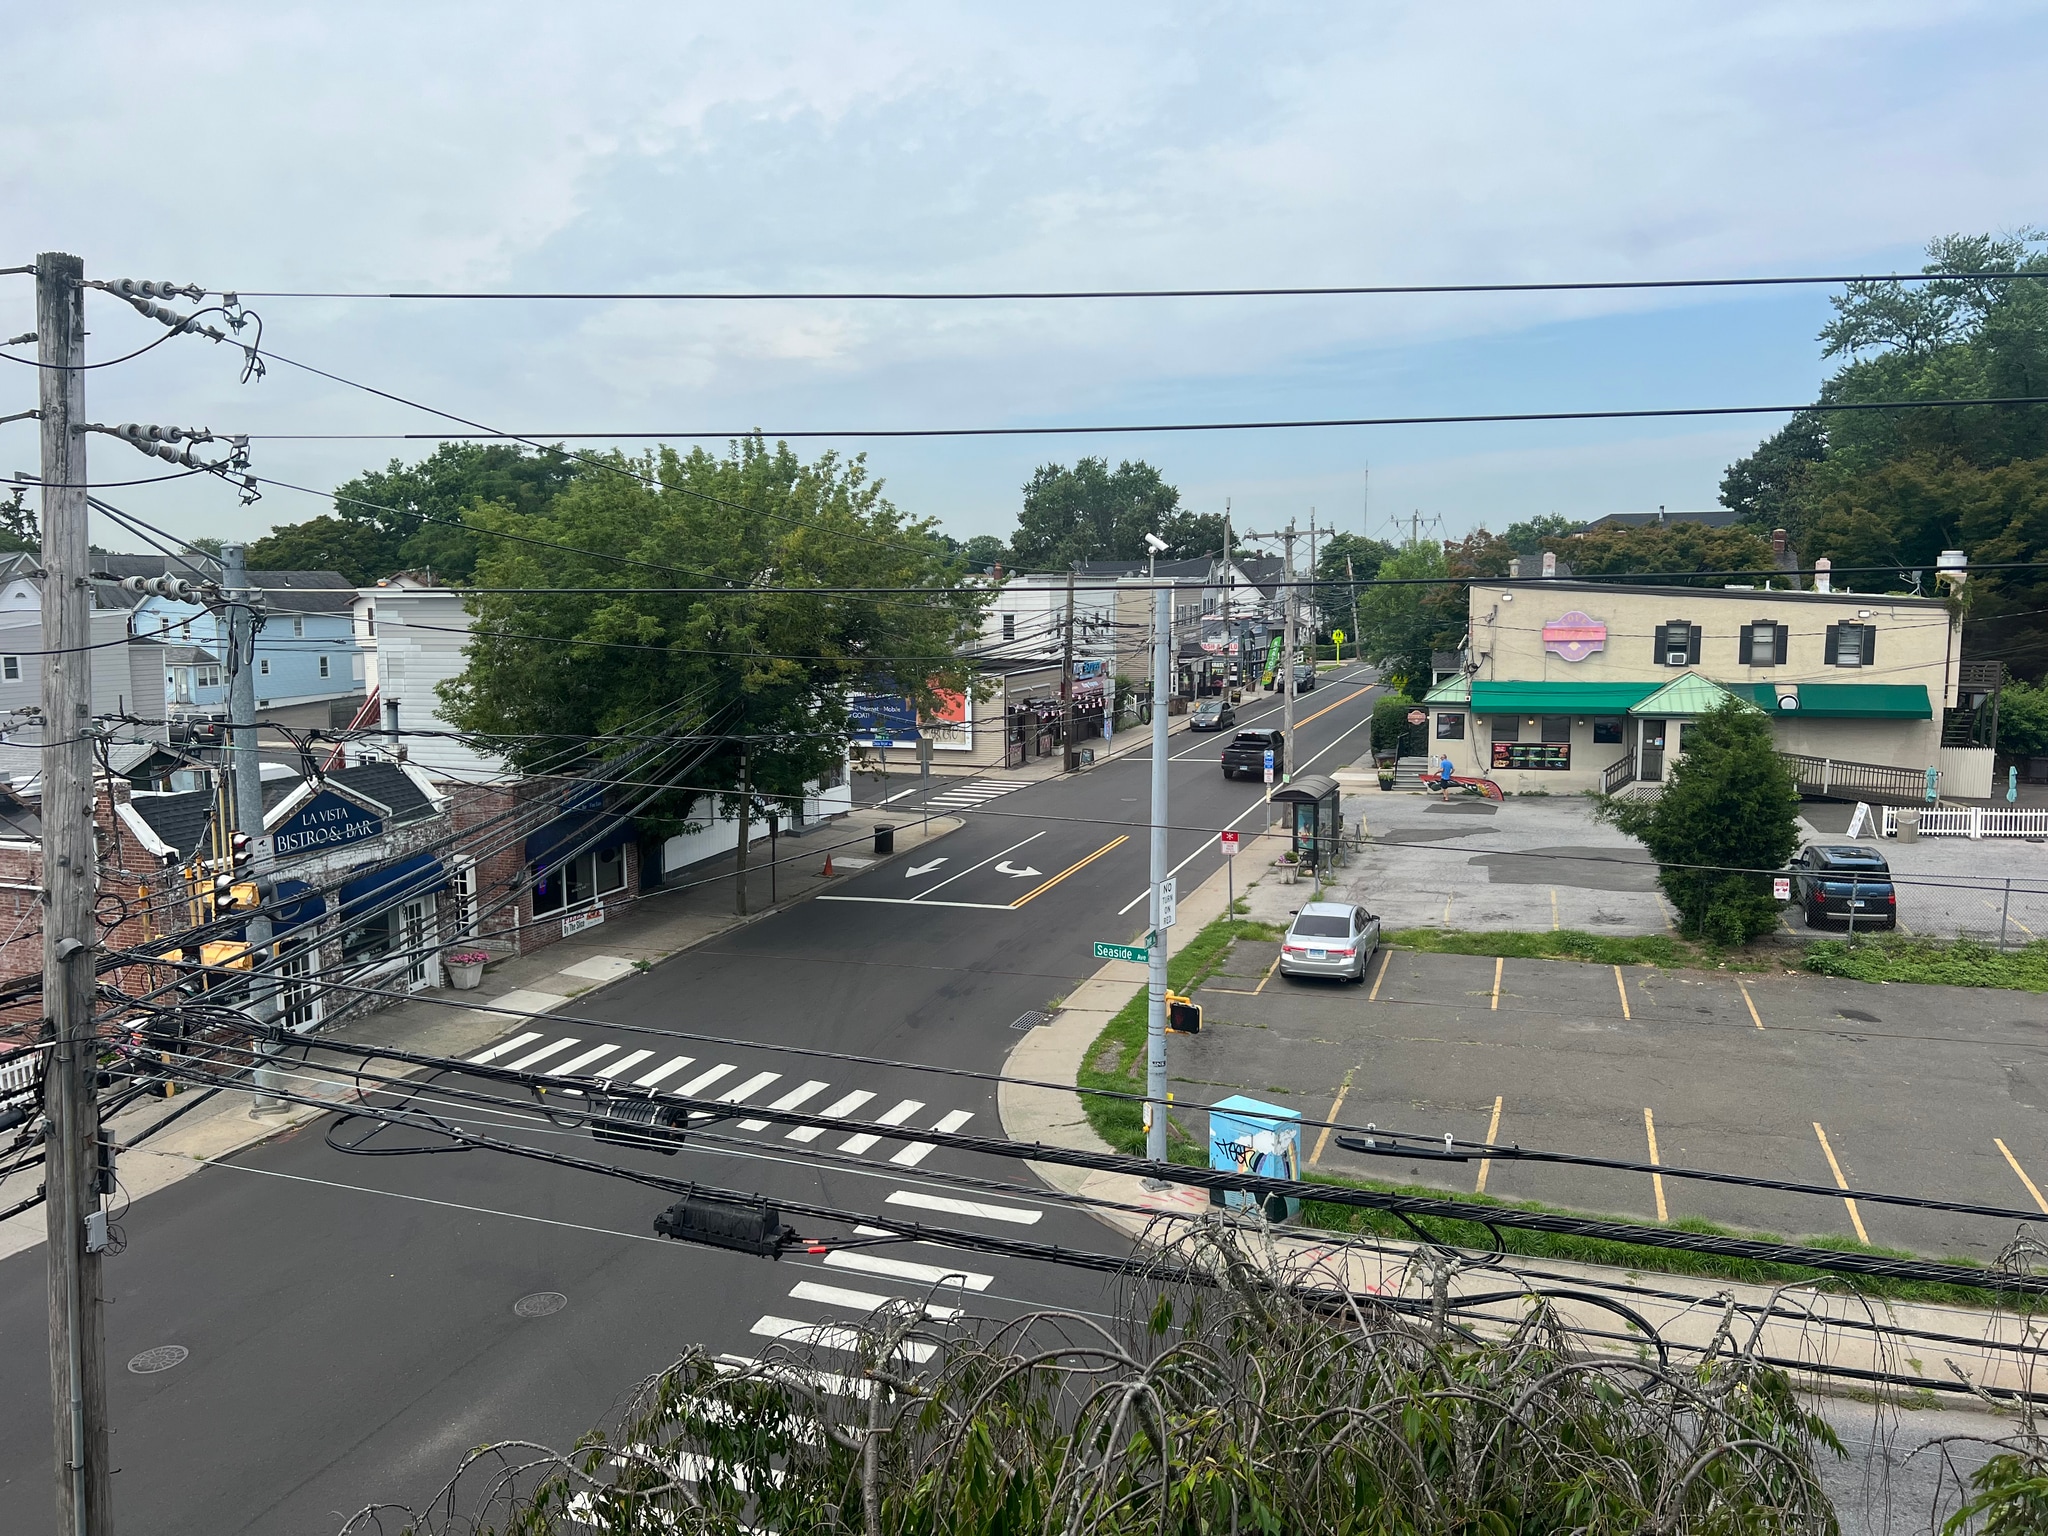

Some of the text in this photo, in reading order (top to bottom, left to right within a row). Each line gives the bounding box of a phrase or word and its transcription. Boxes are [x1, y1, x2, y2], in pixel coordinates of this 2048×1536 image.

[883, 705, 901, 713] Mobile
[303, 807, 348, 826] LA VISTA
[277, 820, 373, 852] BISTRO & BAR
[1163, 882, 1172, 894] NO
[1162, 894, 1173, 904] TURN
[1164, 906, 1171, 914] ON
[1163, 915, 1172, 925] RED
[564, 925, 569, 935] By
[576, 920, 585, 930] Slice
[1097, 944, 1147, 961] Seaside Ave
